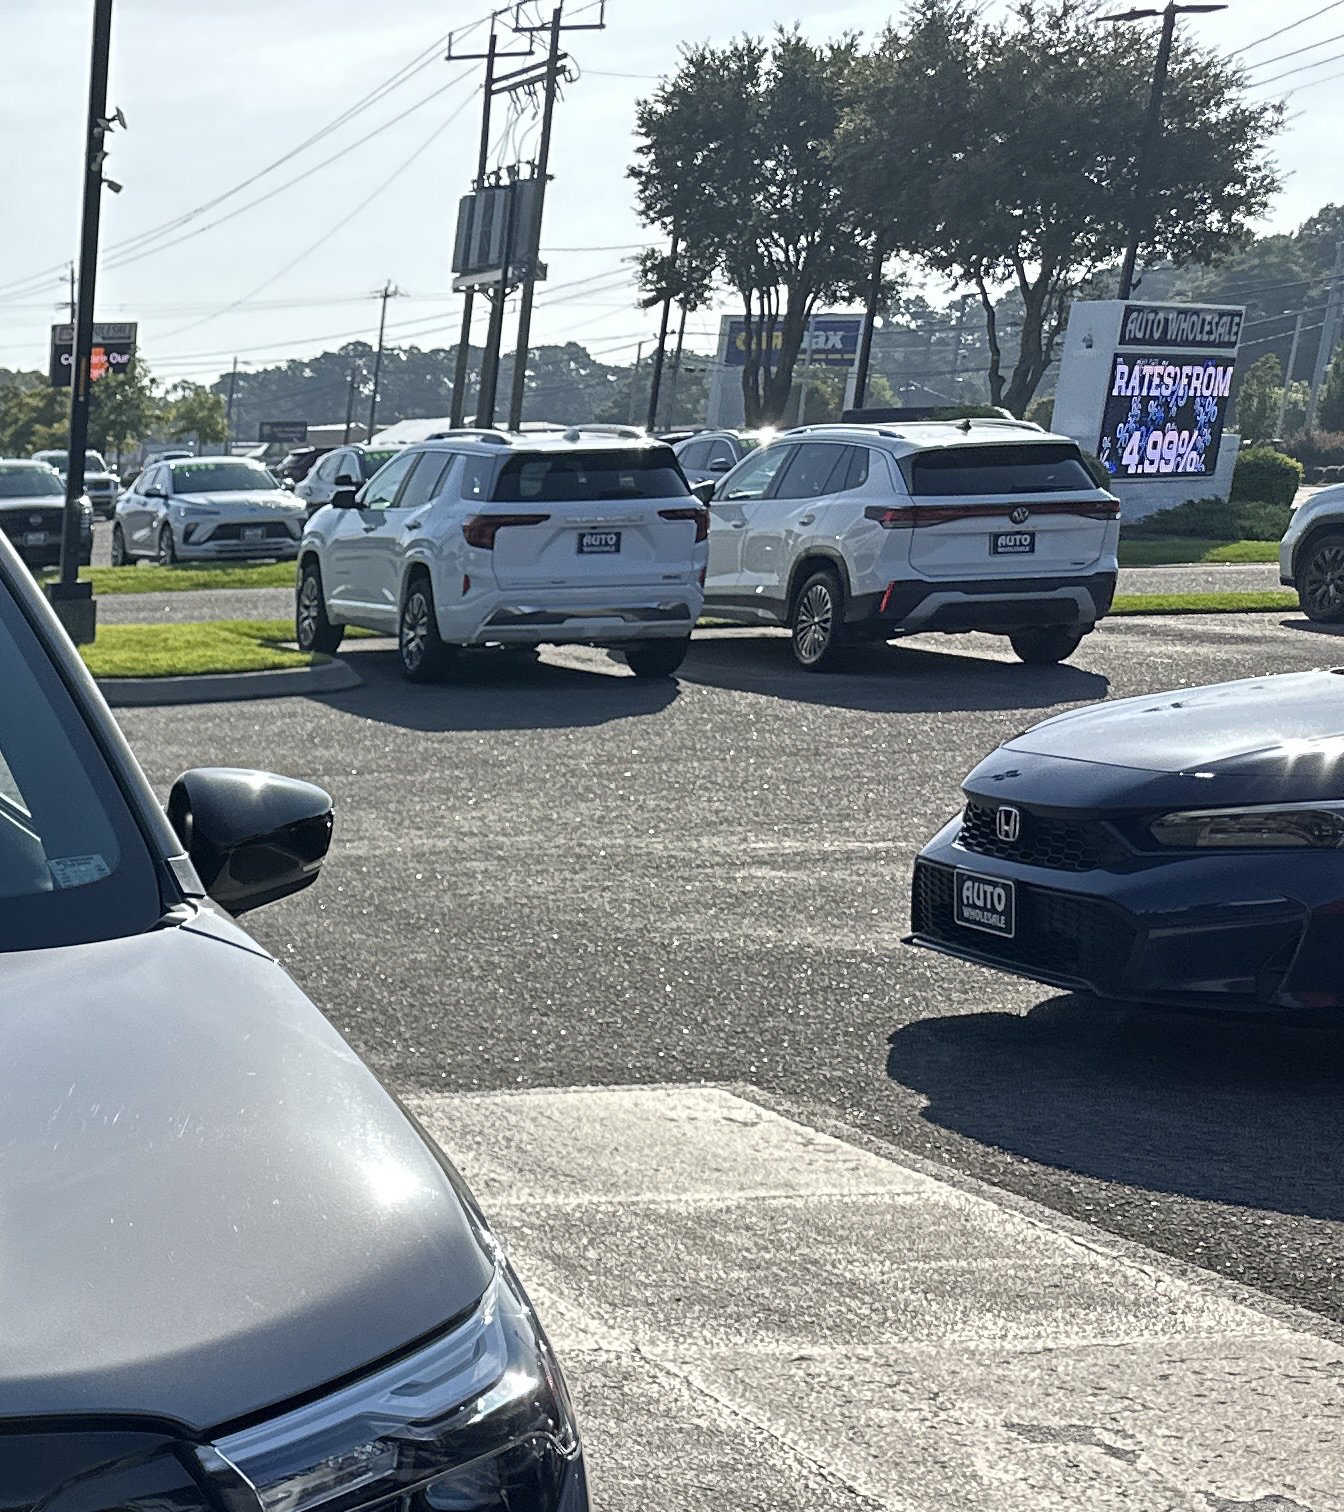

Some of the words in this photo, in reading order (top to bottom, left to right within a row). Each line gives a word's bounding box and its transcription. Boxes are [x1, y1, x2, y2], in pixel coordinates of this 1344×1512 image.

[1126, 311, 1164, 341] AUTO
[1167, 312, 1241, 344] WHOLESALE
[1112, 364, 1176, 396] RATES
[1177, 366, 1234, 397] FROM
[583, 534, 616, 547] AUTO
[997, 534, 1031, 547] AUTO
[962, 880, 1006, 912] AUTO
[962, 905, 1006, 928] WHOLESALE
